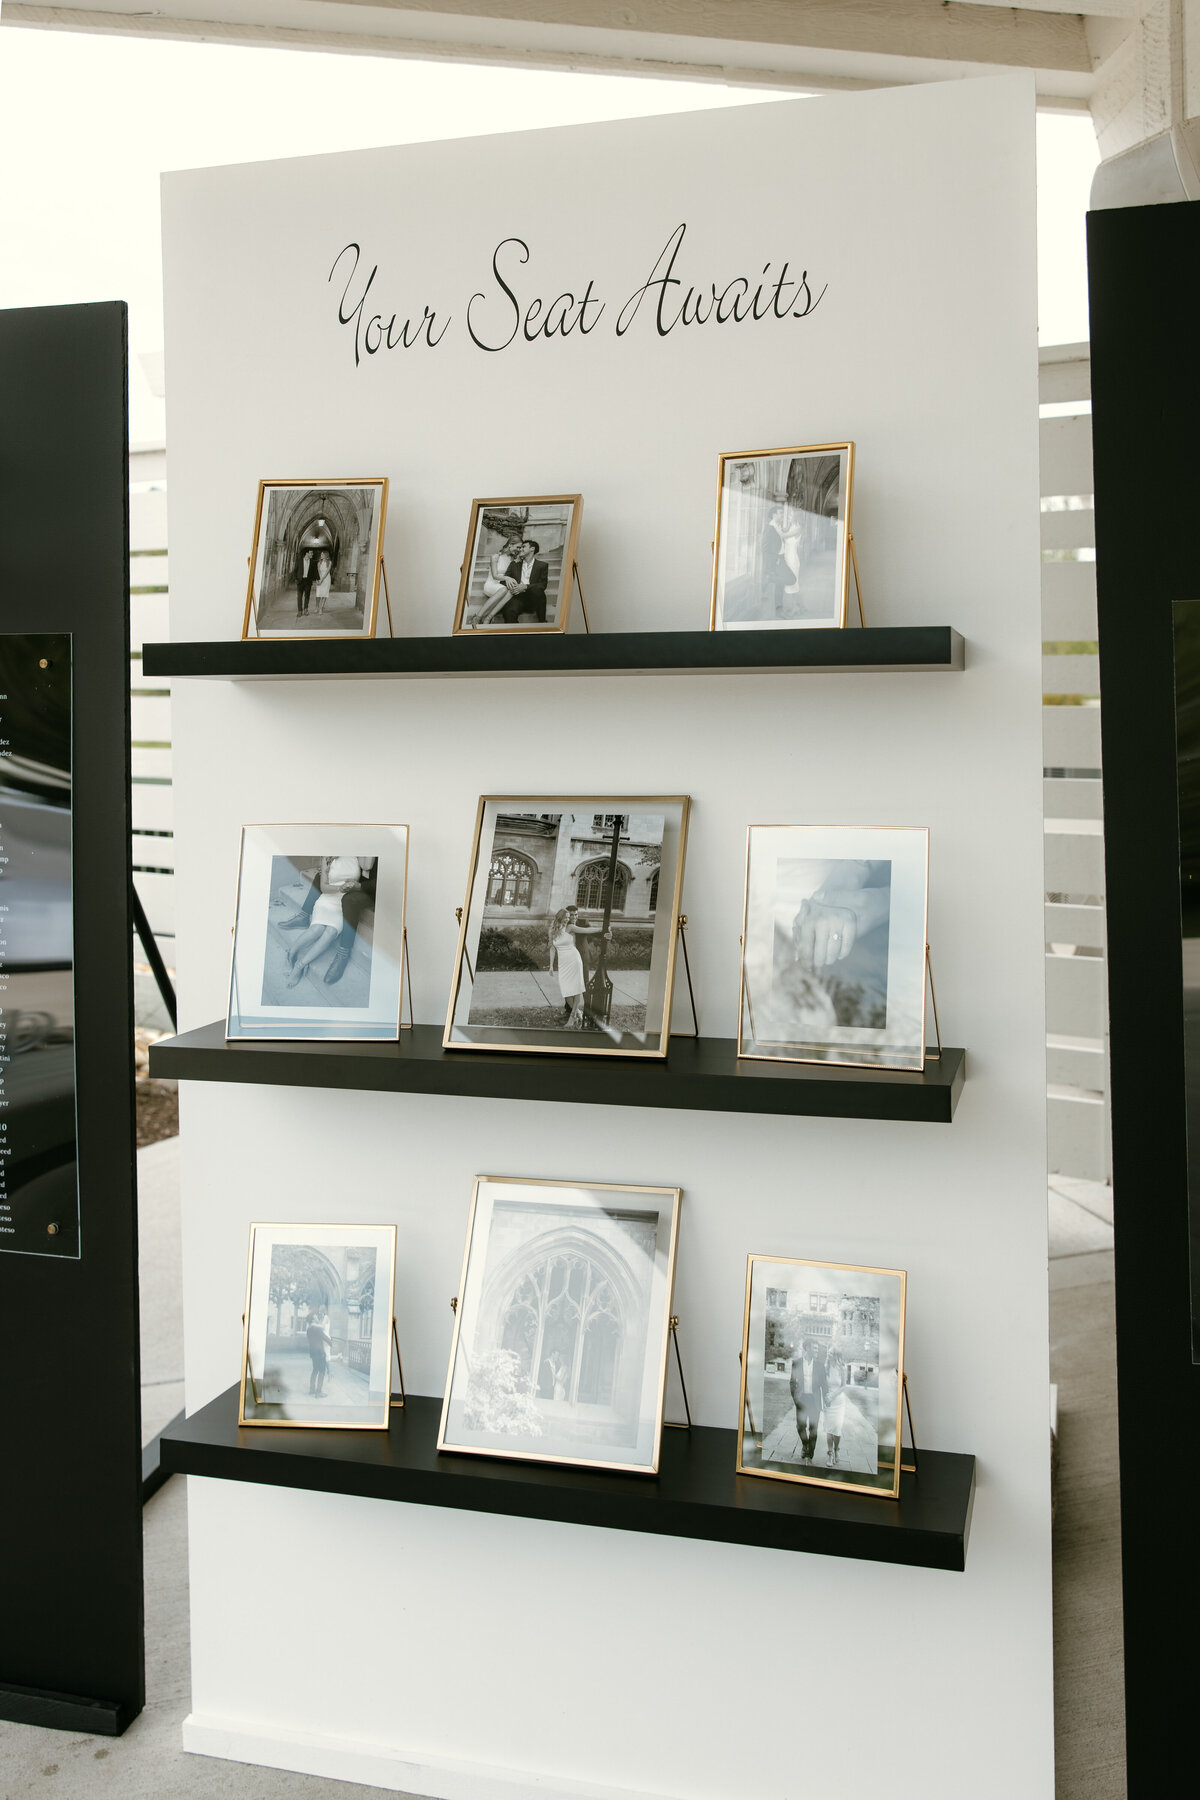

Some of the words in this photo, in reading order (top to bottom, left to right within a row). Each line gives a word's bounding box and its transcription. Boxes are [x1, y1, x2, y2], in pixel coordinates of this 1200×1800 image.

[328, 242, 452, 368] Your
[466, 237, 606, 352] Seat
[615, 222, 829, 337] Awaits
